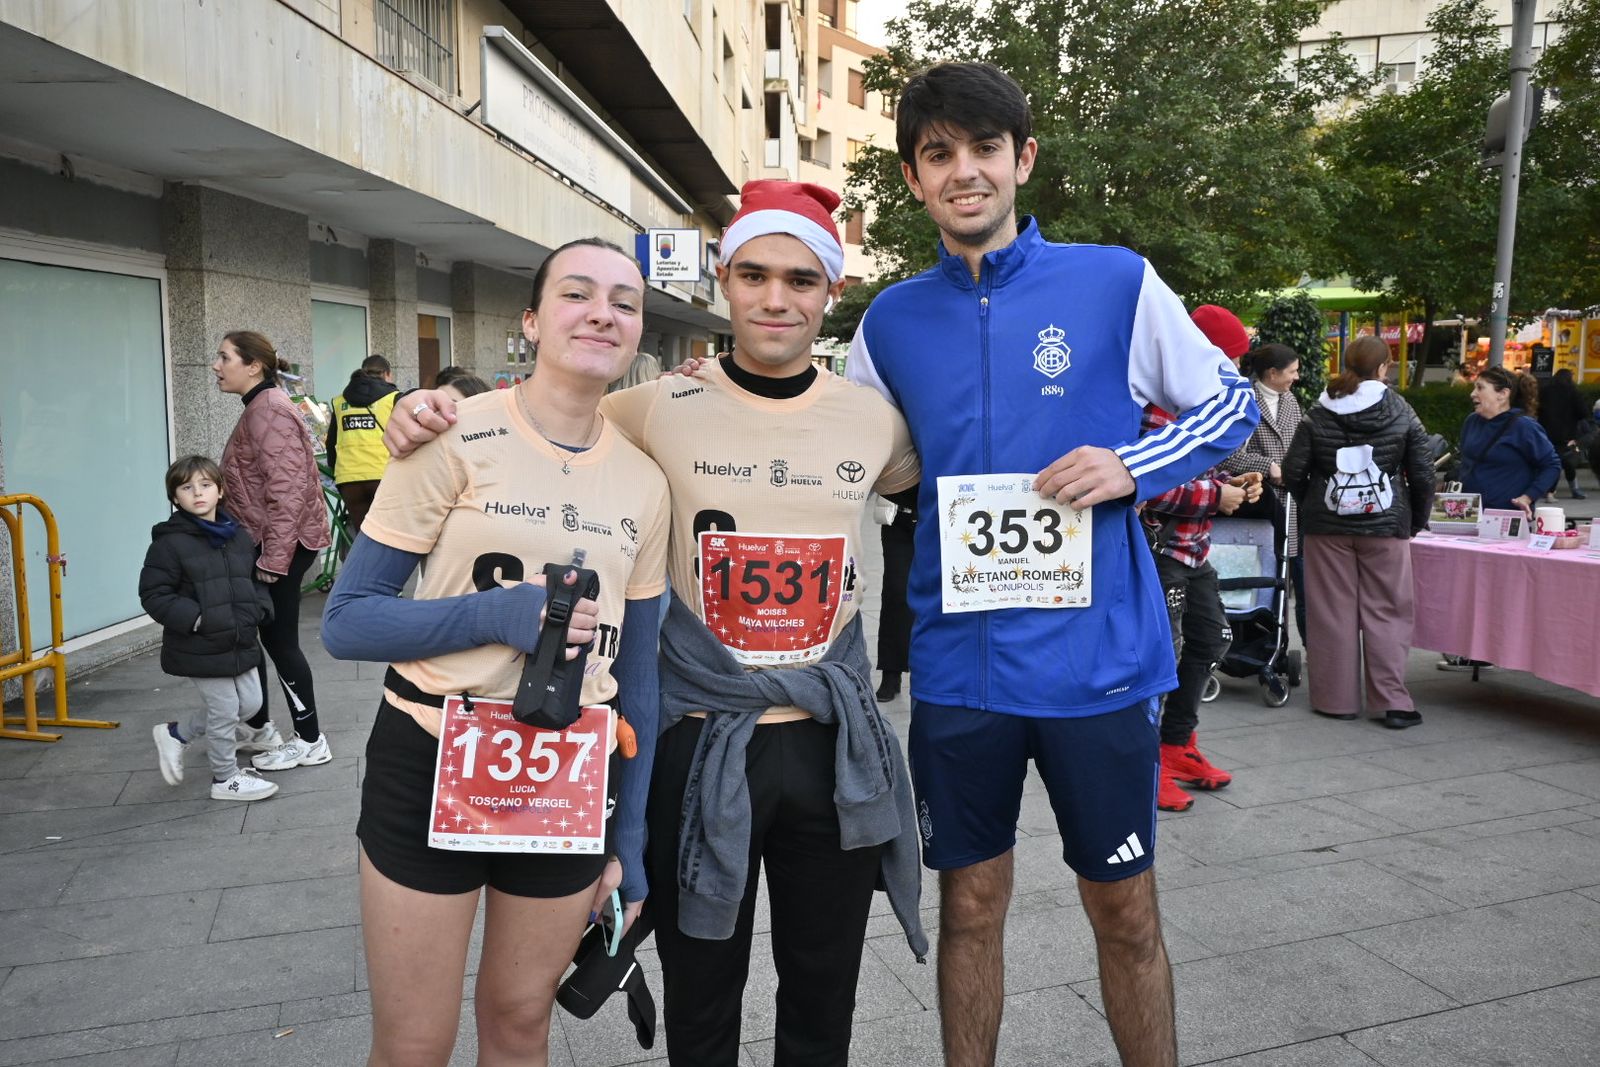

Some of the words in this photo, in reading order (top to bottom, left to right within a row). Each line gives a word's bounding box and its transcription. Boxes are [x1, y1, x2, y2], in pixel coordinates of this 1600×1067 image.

[672, 387, 703, 399] luanvi
[1041, 385, 1064, 397] 1889
[350, 420, 374, 428] ONCE
[461, 428, 496, 443] luanvi
[694, 461, 752, 477] Huelva
[988, 483, 1013, 492] Huelva
[485, 502, 548, 518] Huelva
[582, 525, 612, 536] HUELVA
[967, 508, 1063, 556] 353
[710, 537, 726, 547] 5K
[738, 543, 767, 552] Huelva
[711, 557, 831, 605] 1531
[952, 570, 1018, 585] CAYETANO
[1022, 570, 1082, 582] ROMERO
[997, 583, 1044, 592] ONUPOLIS
[757, 608, 787, 616] MOISES
[738, 616, 762, 627] MAYA
[765, 618, 804, 627] VILCHES
[452, 726, 598, 783] 1357
[510, 785, 536, 793] LUCIA
[469, 796, 522, 807] TOSCANO
[528, 798, 572, 808] VERGEL
